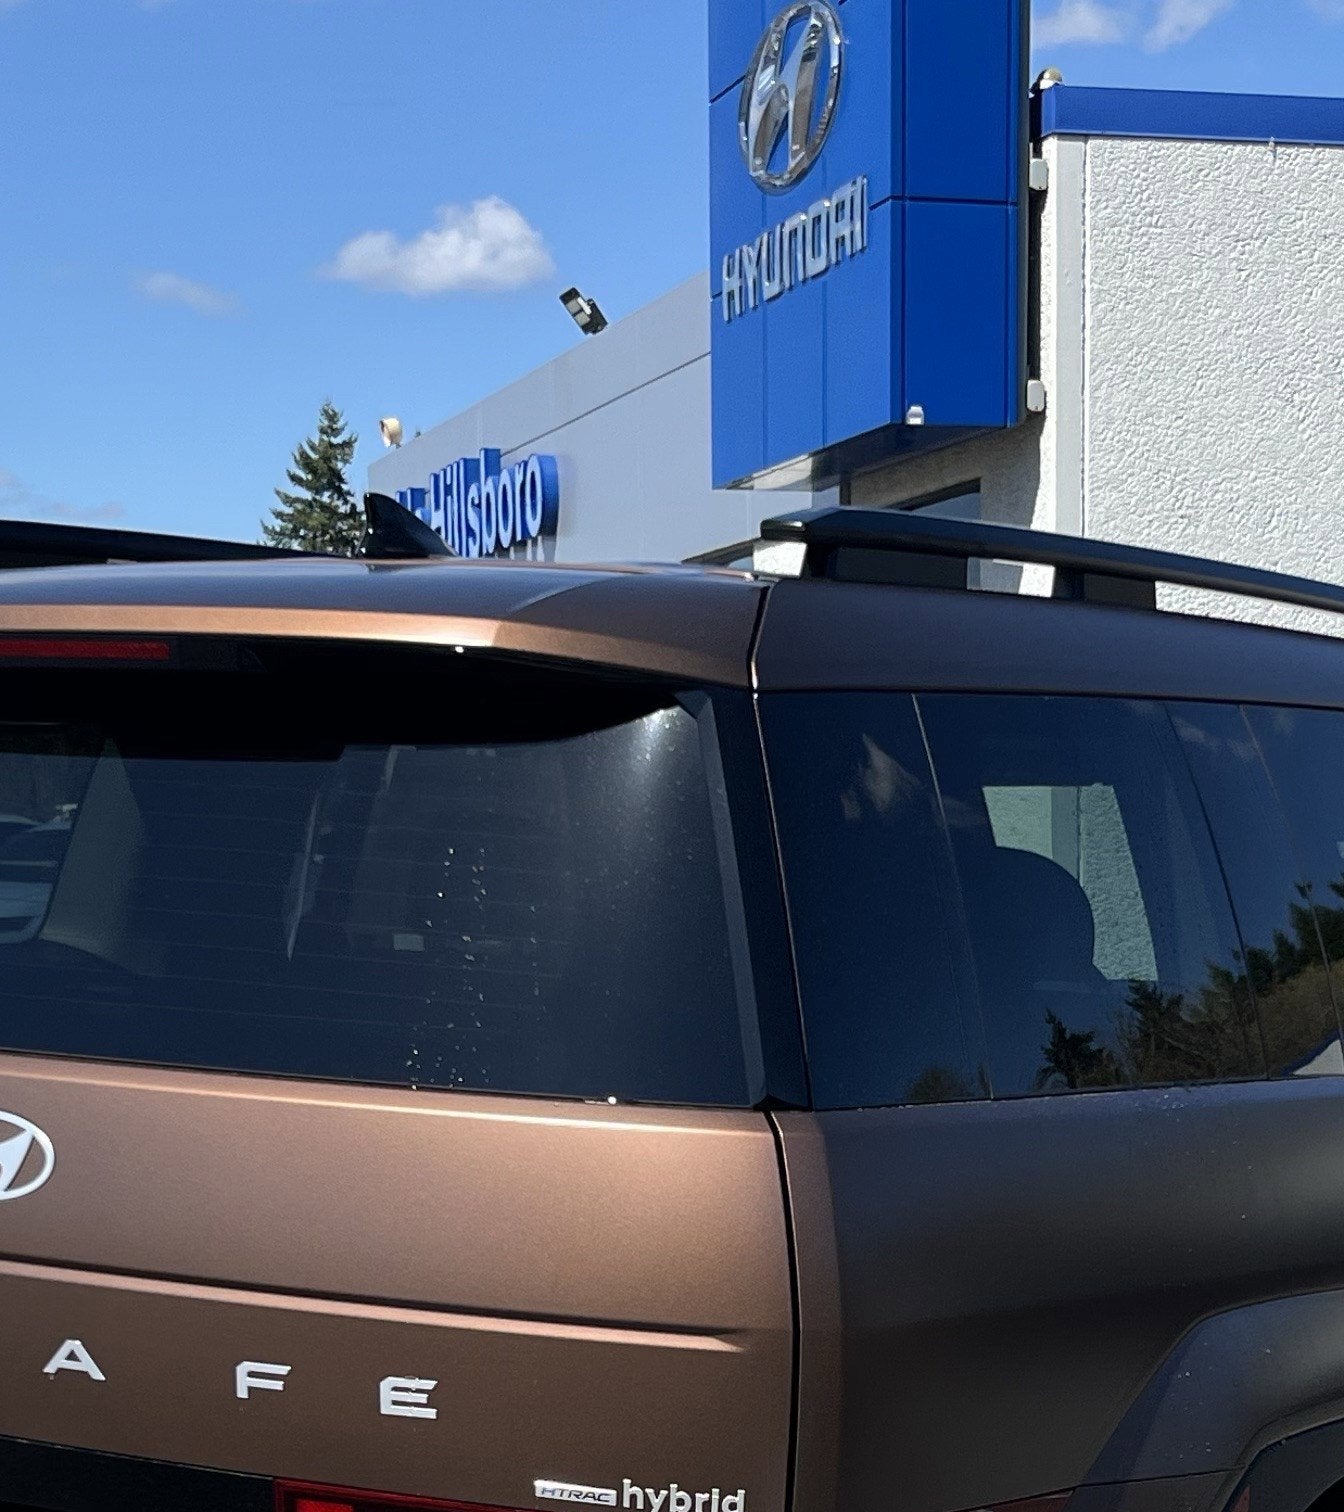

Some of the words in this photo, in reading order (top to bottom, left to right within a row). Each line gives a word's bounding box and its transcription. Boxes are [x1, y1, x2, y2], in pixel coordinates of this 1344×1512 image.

[722, 175, 868, 322] HYUNDAI
[430, 447, 559, 558] Hillsboro
[236, 1360, 439, 1420] FE
[540, 1486, 612, 1503] HTRAC
